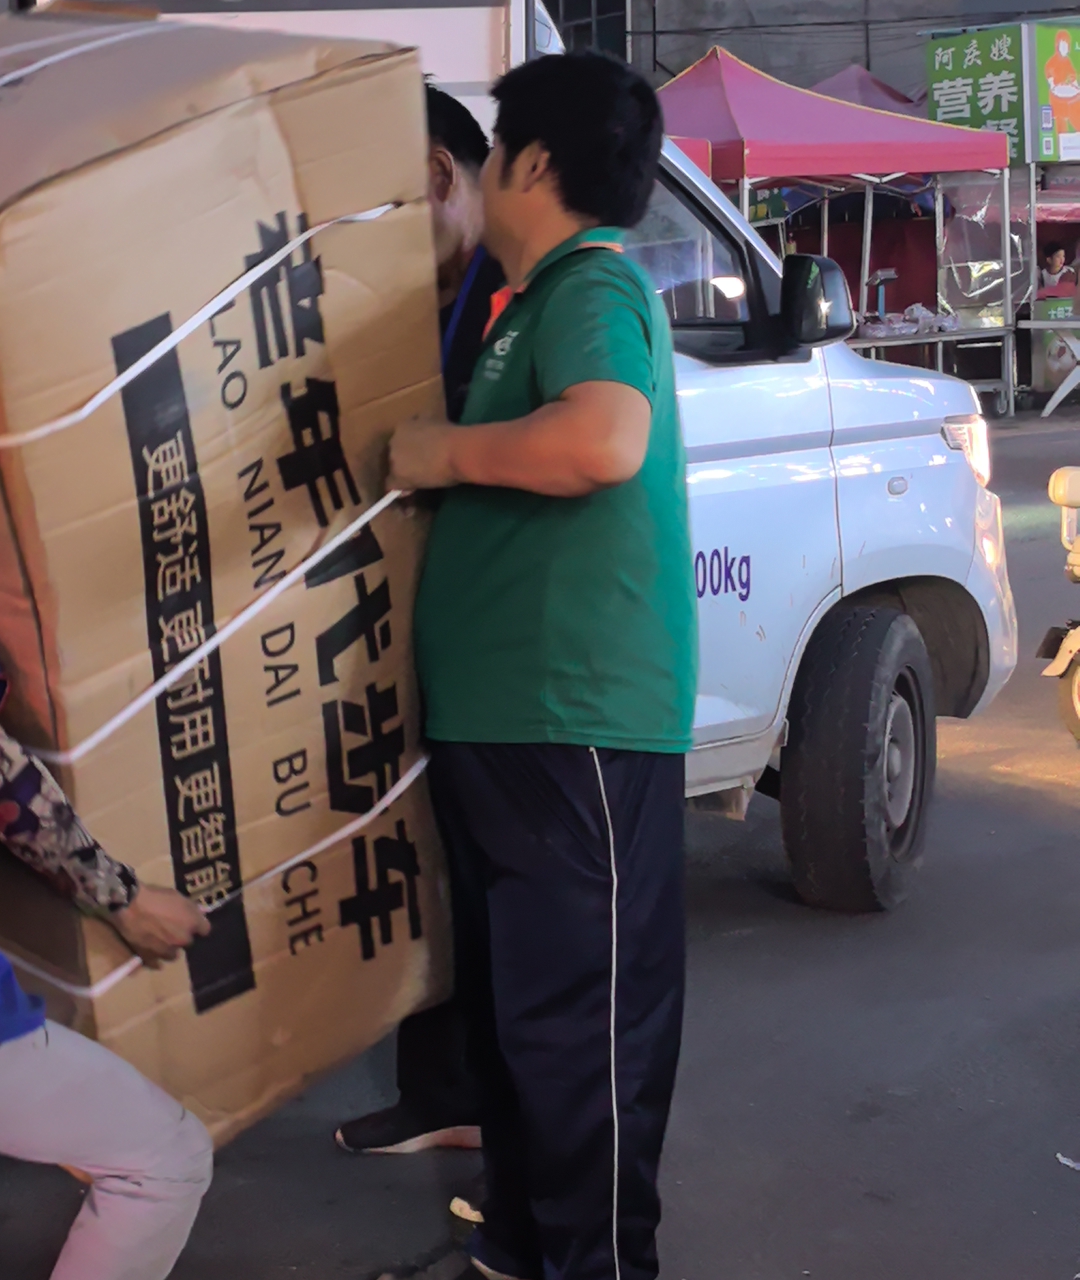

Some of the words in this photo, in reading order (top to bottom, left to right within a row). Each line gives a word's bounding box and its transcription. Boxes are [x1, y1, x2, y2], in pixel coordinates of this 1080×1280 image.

[932, 70, 1018, 121] 营养
[207, 300, 246, 411] LAO
[237, 458, 288, 589] NIAN
[243, 210, 421, 960] 老年代步车
[695, 546, 750, 601] 00kg
[261, 622, 301, 708] DAI
[272, 748, 311, 818] BU
[281, 860, 323, 956] CHE
